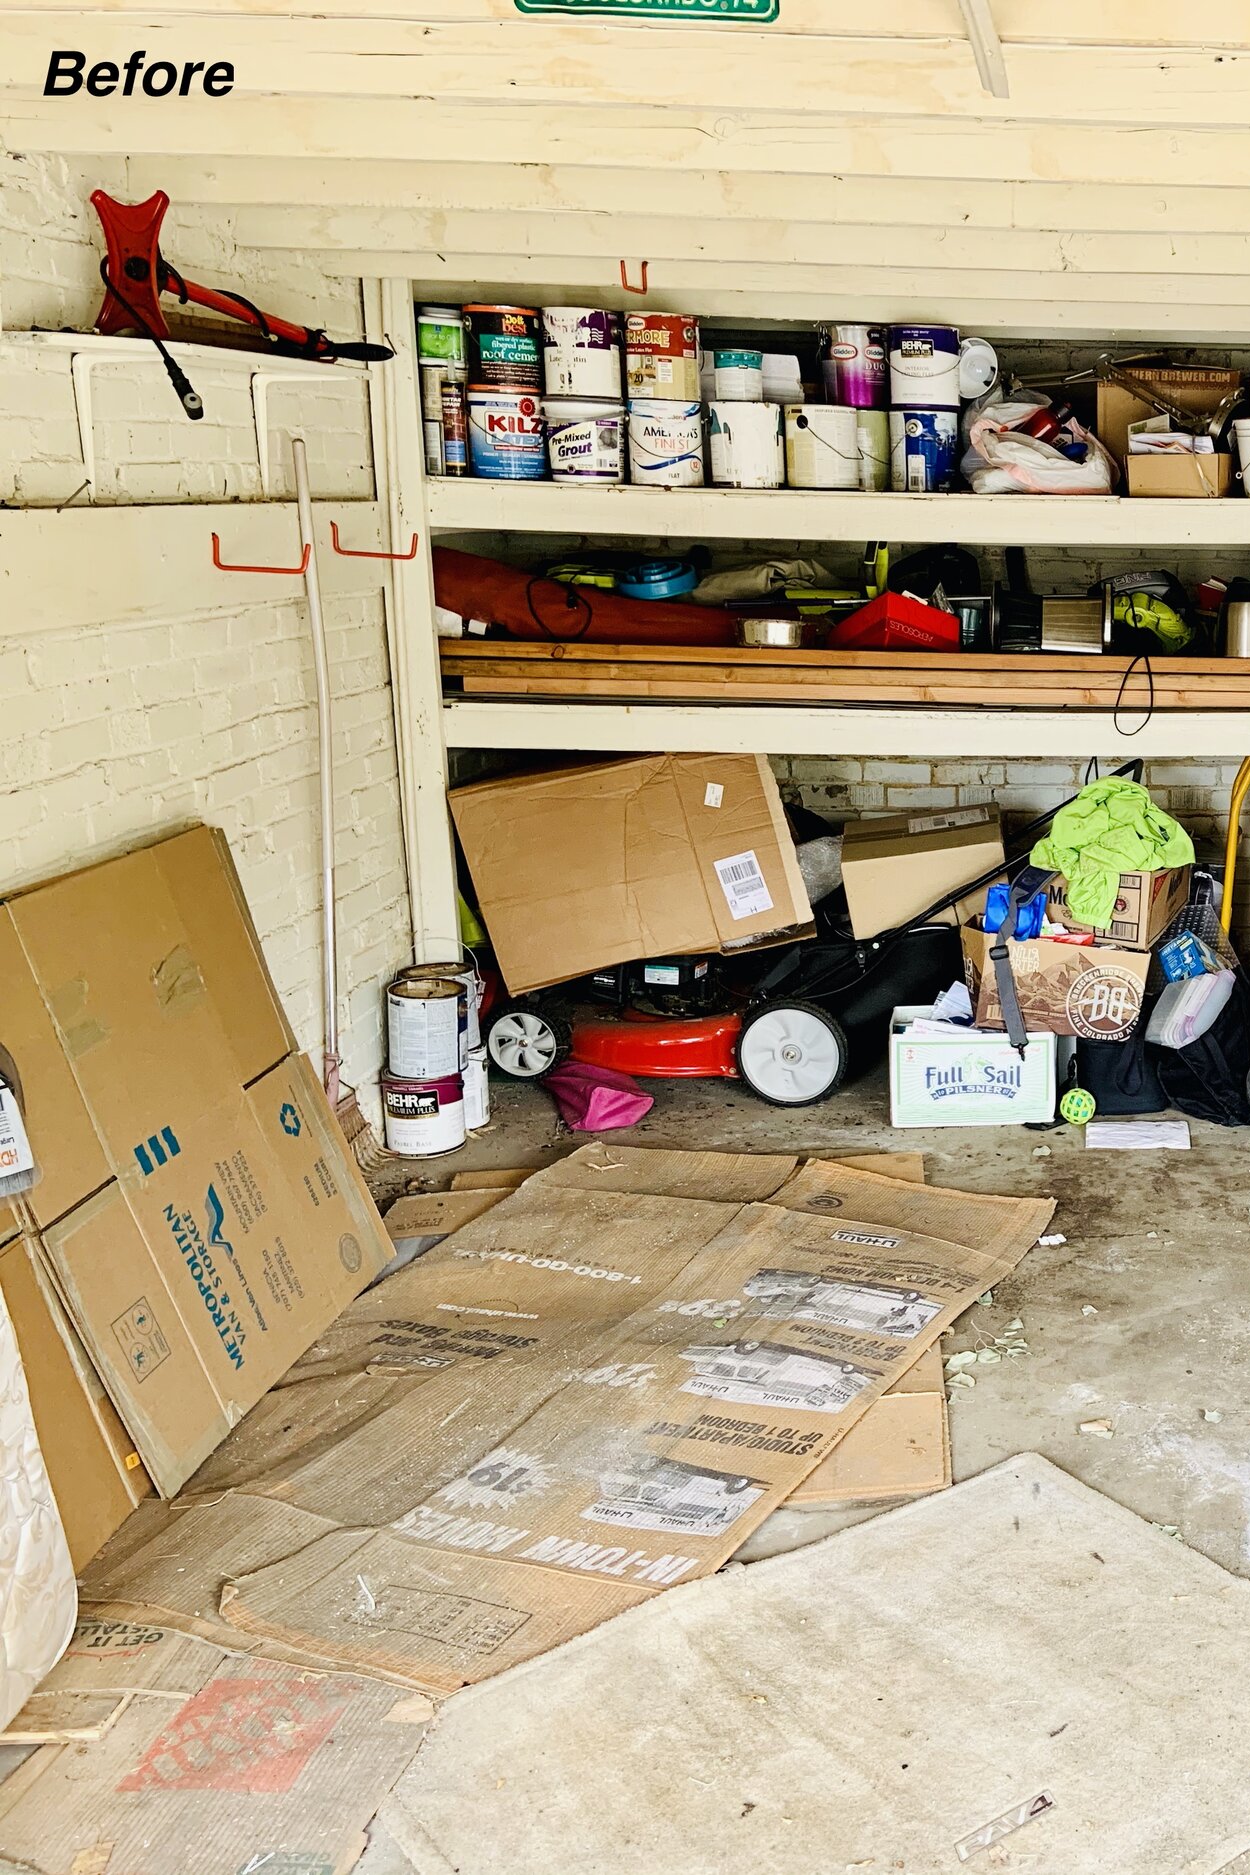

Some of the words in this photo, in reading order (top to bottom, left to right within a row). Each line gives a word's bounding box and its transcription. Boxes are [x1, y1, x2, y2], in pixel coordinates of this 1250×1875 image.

[502, 318, 528, 334] best
[491, 340, 517, 350] fibered
[517, 341, 536, 351] plastic
[833, 347, 856, 356] Glidden
[901, 340, 922, 350] BEHR
[482, 348, 505, 360] roof
[865, 362, 886, 371] DUO
[633, 373, 644, 384] 20
[487, 414, 544, 435] KILZ
[551, 430, 592, 447] Pre-Mixed
[557, 442, 593, 458] Grout
[692, 461, 699, 470] 12
[889, 619, 935, 643] AEROSOLES
[1071, 968, 1125, 999] BRECKENRIDGE
[1070, 1009, 1084, 1028] FINE
[1081, 1027, 1125, 1041] COLORADO
[925, 1065, 963, 1089] Full
[983, 1065, 1022, 1088] Sail
[946, 1084, 1002, 1095] PILSNER
[386, 1092, 419, 1108] BEHR
[388, 1106, 416, 1115] PREMIUM
[416, 1105, 436, 1115] PLUS
[213, 1161, 229, 1187] VIEW
[318, 1155, 333, 1184] CUBE
[231, 1155, 262, 1218] SACRAMENTO
[313, 1161, 331, 1200] MEDIUM
[223, 1187, 250, 1235] MOUNTAIN
[836, 1231, 897, 1249] U-HAUL
[181, 1209, 223, 1288] STORAGE
[232, 1257, 248, 1288] Lines
[162, 1203, 246, 1371] METROPOLITAN
[219, 1291, 231, 1305] &
[436, 1303, 540, 1321] www.uhaul.com
[812, 1311, 849, 1325] U-HAUL
[227, 1310, 247, 1345] VAN
[378, 1319, 452, 1338] Boxes
[450, 1329, 539, 1349] Storage
[888, 1343, 907, 1354] UP
[690, 1380, 729, 1394] U-HAUL
[763, 1391, 800, 1404] U-HAUL
[697, 1413, 762, 1436] BEDROOM
[765, 1424, 775, 1437] 1
[778, 1426, 796, 1439] TO
[642, 1420, 815, 1457] STUDIO/APARTMENT
[798, 1431, 824, 1445] UP
[592, 1506, 633, 1520] U-HAUL
[389, 1504, 533, 1553] MOVES
[659, 1516, 696, 1528] U-HAUL
[514, 1534, 701, 1585] IN-TOWN
[86, 1635, 113, 1648] IT
[114, 1631, 165, 1647] GET
[959, 1794, 1054, 1861] RAV4
